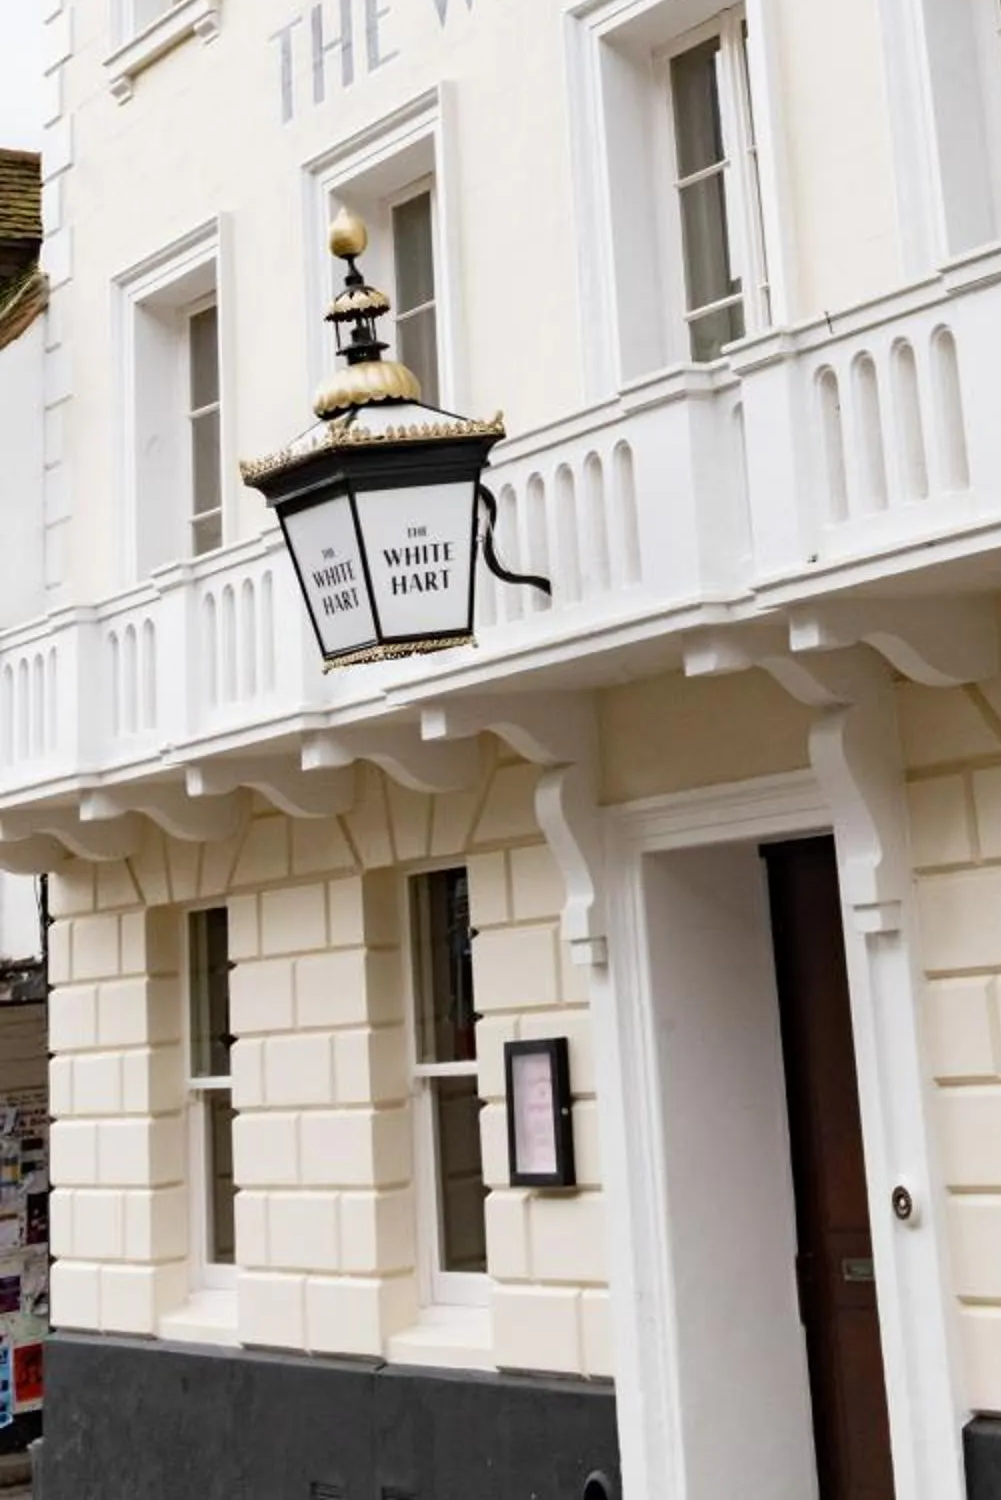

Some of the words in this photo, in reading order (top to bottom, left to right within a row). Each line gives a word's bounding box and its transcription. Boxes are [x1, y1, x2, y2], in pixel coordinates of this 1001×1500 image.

[407, 526, 427, 539] THE
[383, 541, 455, 568] WHITE
[311, 560, 356, 589] WHITE
[391, 569, 452, 596] HART
[321, 587, 360, 616] HART
